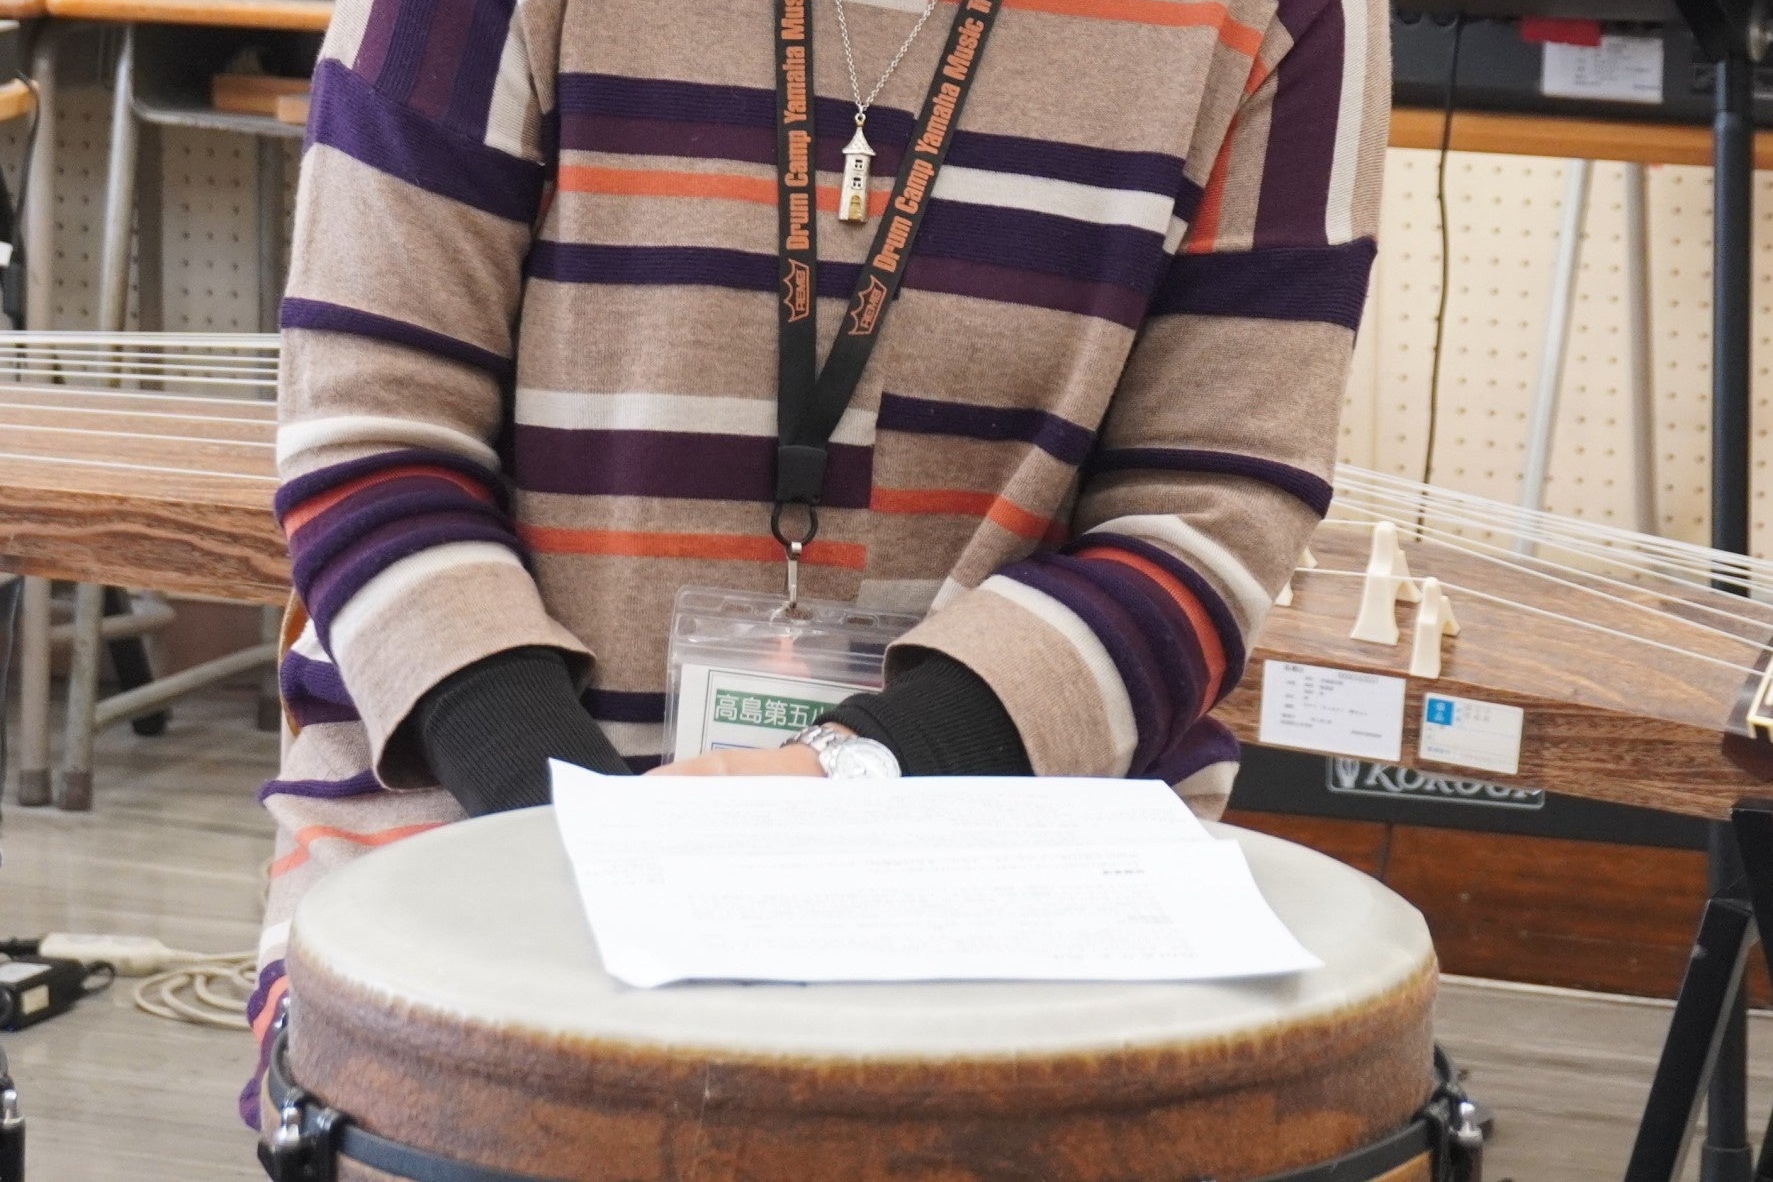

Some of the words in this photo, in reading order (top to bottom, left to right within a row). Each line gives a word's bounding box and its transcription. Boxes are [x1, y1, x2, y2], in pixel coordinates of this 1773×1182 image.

[943, 17, 985, 81] Music
[782, 45, 808, 124] Yamaha
[914, 81, 961, 155] Yamaha
[784, 129, 812, 187] Camp
[894, 158, 935, 215] Camp
[785, 192, 810, 250] Drum
[873, 215, 913, 274] Drum
